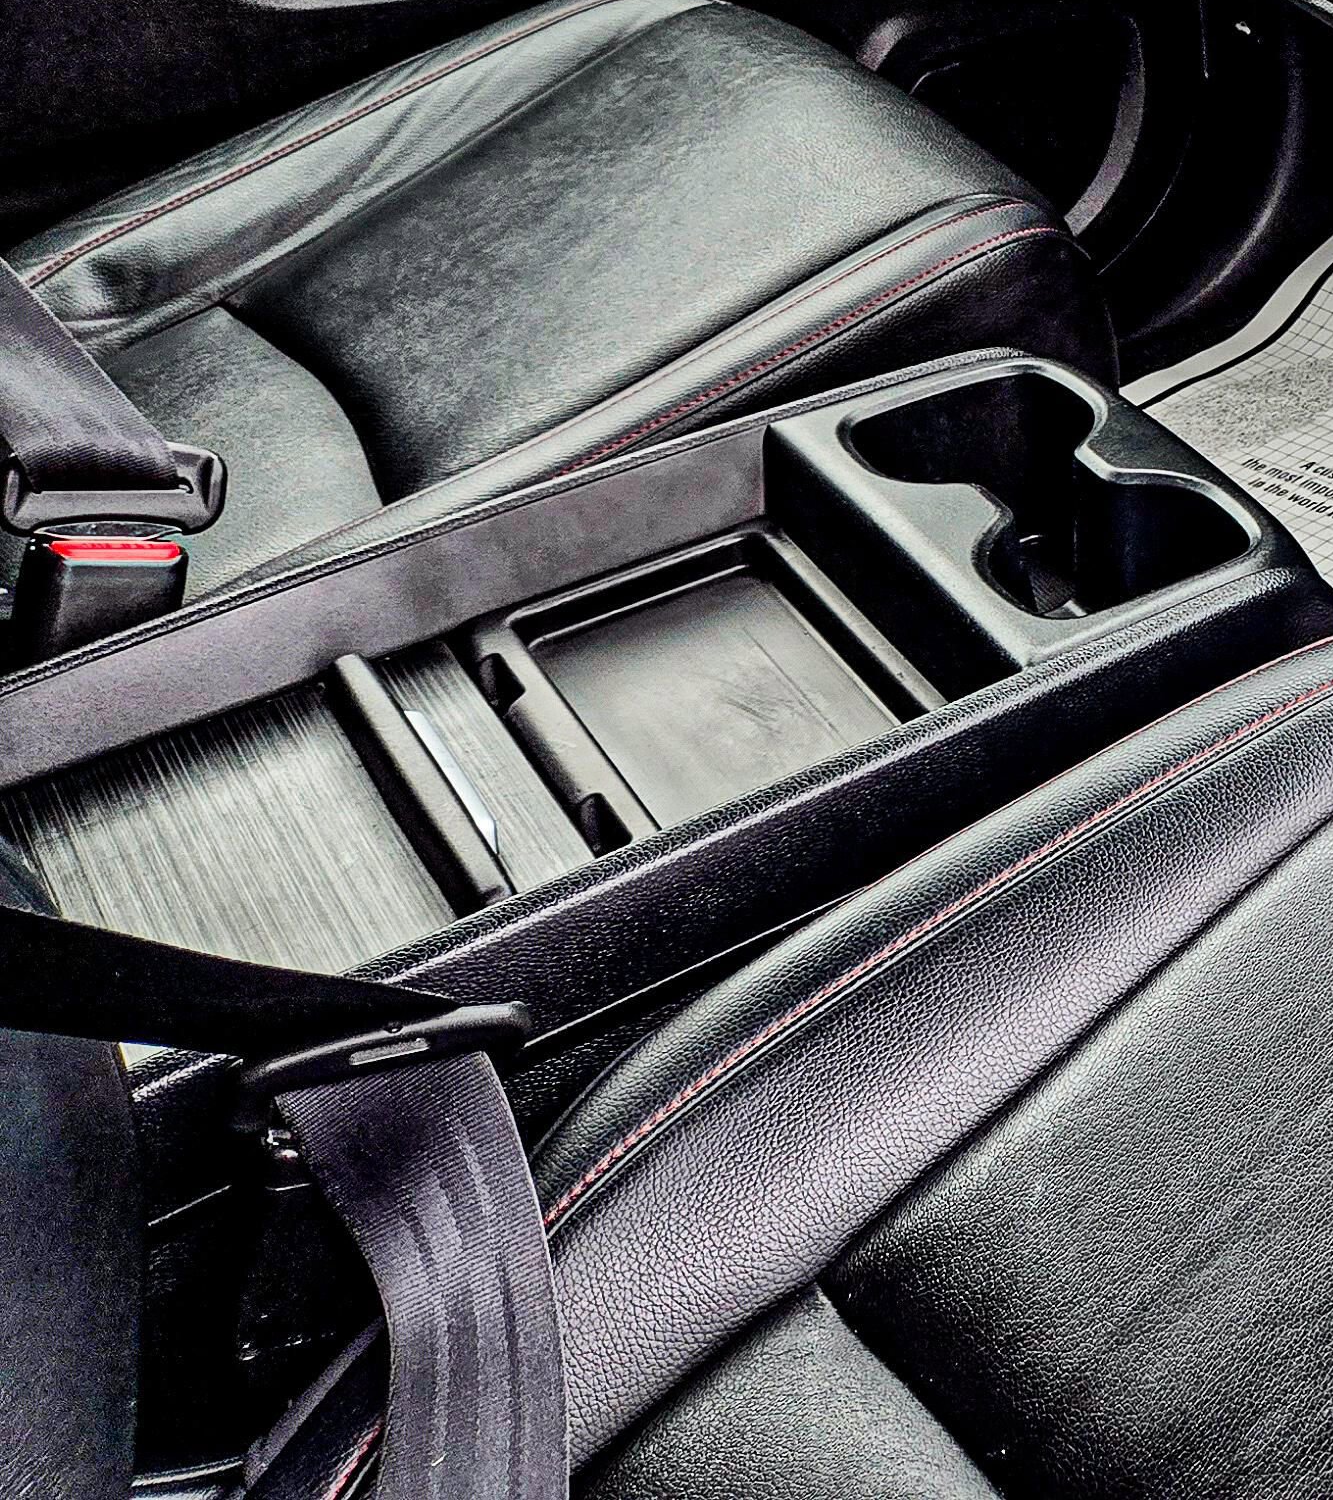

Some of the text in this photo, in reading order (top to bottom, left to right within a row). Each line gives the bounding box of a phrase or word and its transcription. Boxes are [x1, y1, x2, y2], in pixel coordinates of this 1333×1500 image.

[1241, 458, 1266, 472] the
[1264, 467, 1304, 484] most
[1299, 461, 1316, 473] A
[1264, 483, 1289, 497] the
[1288, 492, 1332, 514] world
